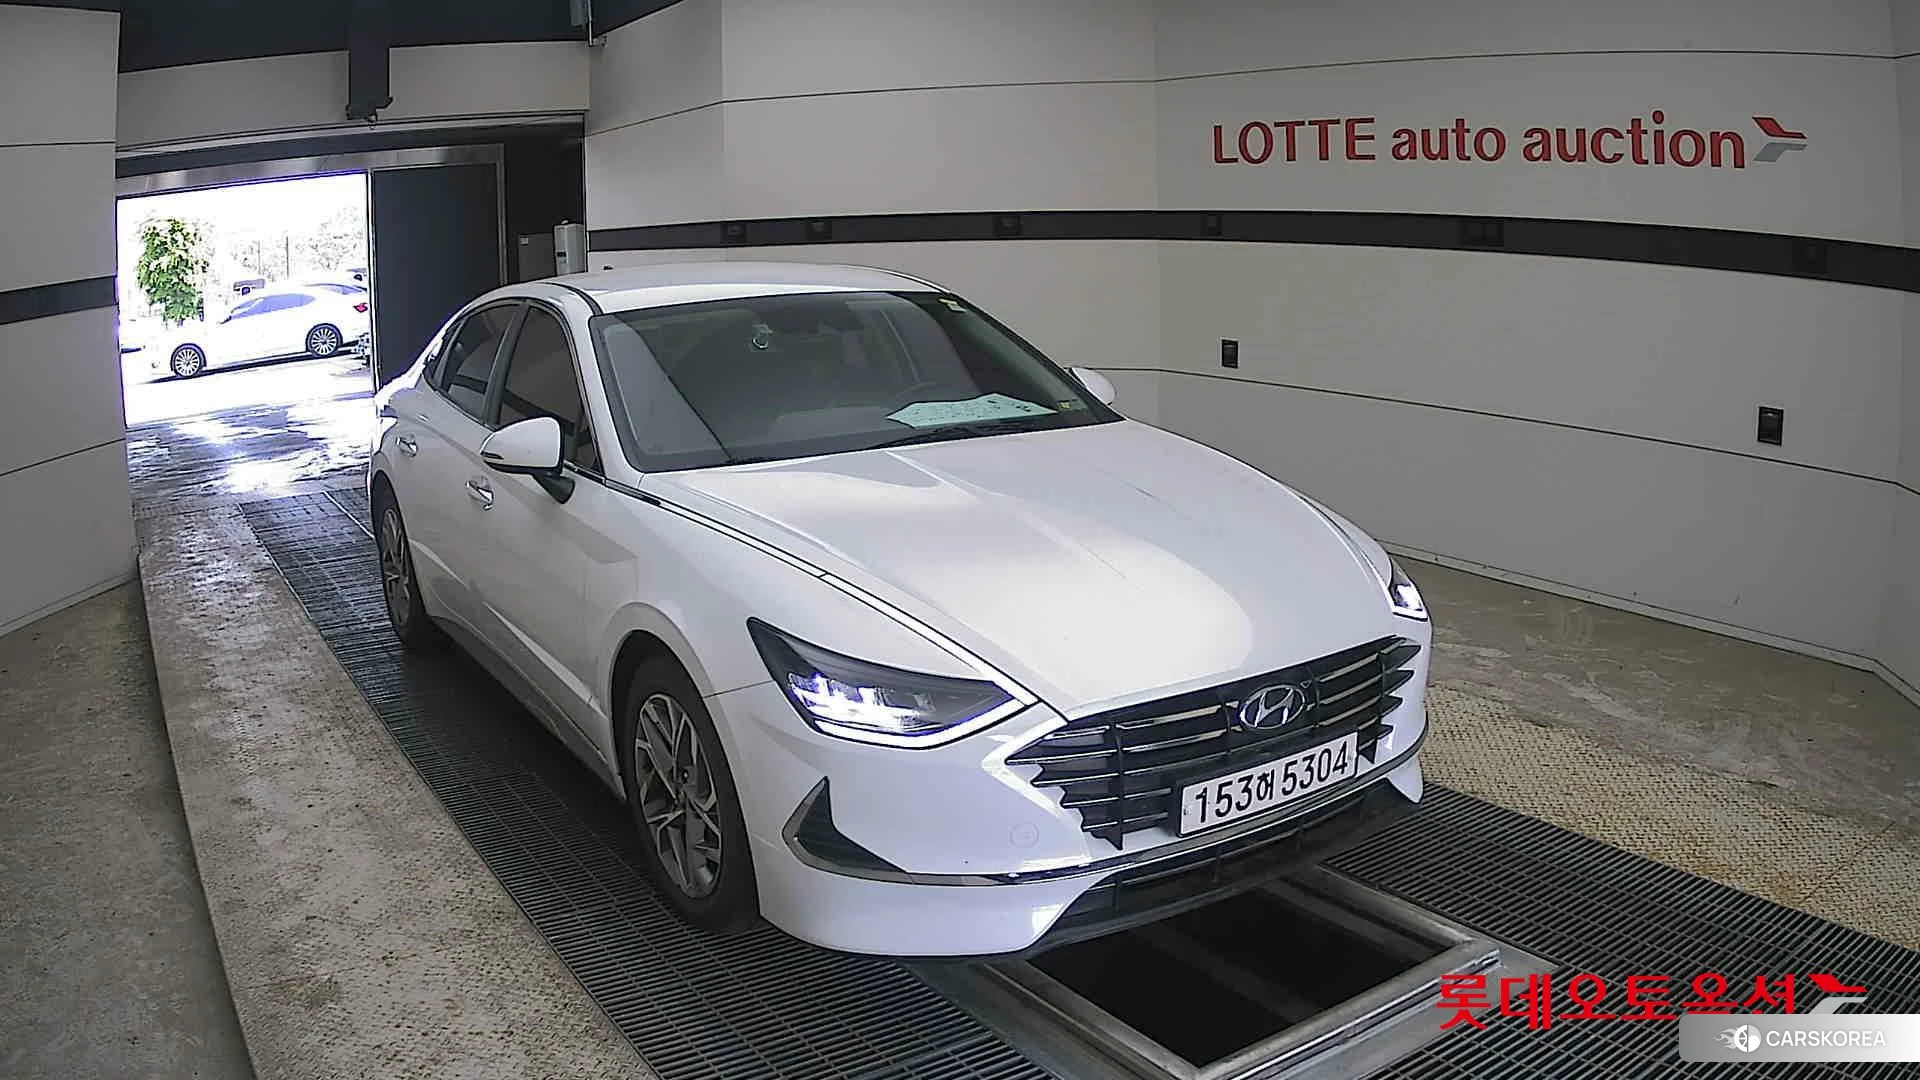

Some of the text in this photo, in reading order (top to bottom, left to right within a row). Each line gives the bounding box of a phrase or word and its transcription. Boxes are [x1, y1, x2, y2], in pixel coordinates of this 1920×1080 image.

[1213, 110, 1744, 168] LOTTE auto auction
